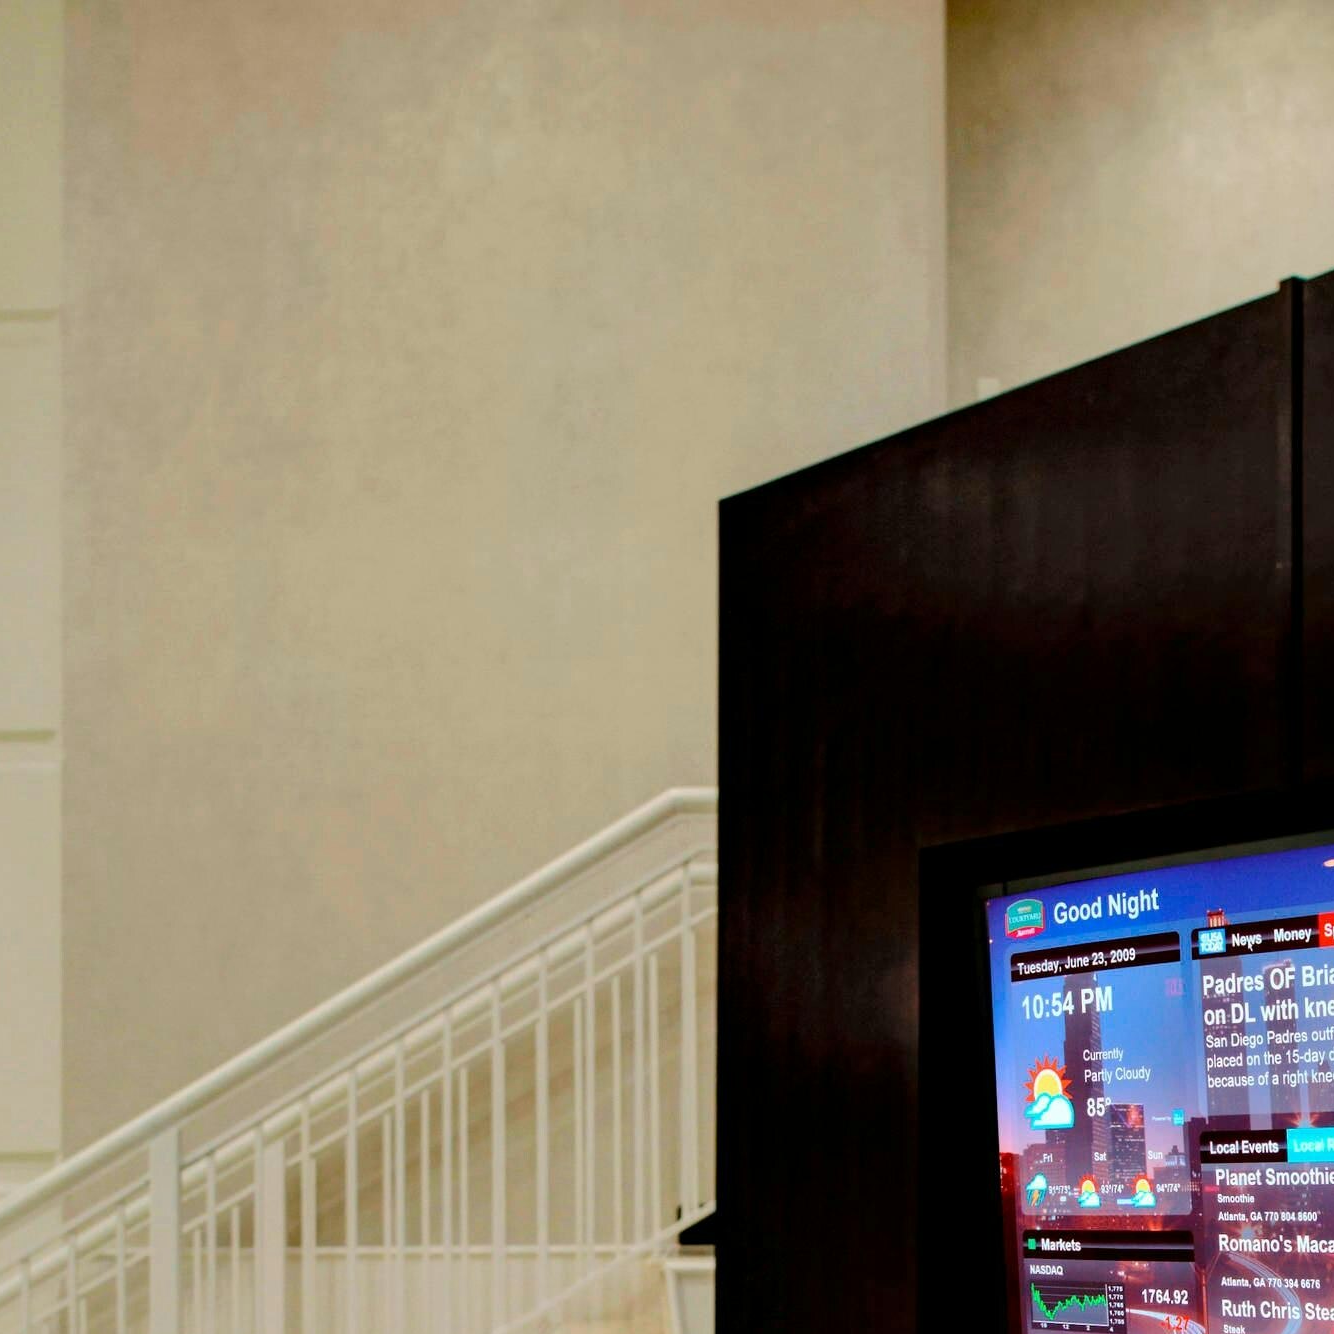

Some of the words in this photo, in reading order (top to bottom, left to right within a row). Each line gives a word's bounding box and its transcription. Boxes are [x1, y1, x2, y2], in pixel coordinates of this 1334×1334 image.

[1054, 897, 1102, 924] Good
[1108, 888, 1159, 919] Night
[1232, 933, 1262, 947] News
[1274, 928, 1312, 942] Money
[1018, 959, 1062, 975] Tuesday,
[1064, 955, 1089, 969] June
[1092, 952, 1107, 966] 23,
[1111, 948, 1136, 962] 2009
[1203, 973, 1264, 995] Padres
[1270, 967, 1295, 990] OF
[1022, 991, 1074, 1020] 10:54
[1081, 986, 1113, 1013] PM
[1204, 1008, 1226, 1025] on
[1231, 1003, 1256, 1024] DL
[1261, 999, 1298, 1021] with
[1206, 1035, 1227, 1048] San
[1231, 1033, 1263, 1048] Diego
[1267, 1030, 1307, 1044] Padres
[1083, 1048, 1123, 1061] Currently
[1207, 1053, 1243, 1071] placed
[1247, 1055, 1260, 1066] on
[1264, 1052, 1282, 1065] the
[1286, 1050, 1325, 1065] 15-day
[1084, 1069, 1112, 1084] Partly
[1115, 1066, 1150, 1081] Cloudy
[1207, 1075, 1254, 1088] because
[1258, 1072, 1269, 1085] of
[1272, 1074, 1279, 1085] a
[1283, 1070, 1308, 1087] right
[1210, 1141, 1238, 1155] Local
[1242, 1140, 1279, 1153] Events
[1293, 1139, 1324, 1153] Local
[1043, 1154, 1053, 1162] Fri
[1094, 1152, 1107, 1161] Sat
[1148, 1151, 1163, 1159] Sun
[1216, 1169, 1261, 1186] Planet
[1217, 1194, 1255, 1203] Smoothie
[1218, 1212, 1248, 1222] Atlanta,
[1251, 1212, 1262, 1221] GA
[1264, 1212, 1278, 1221] 770
[1281, 1212, 1295, 1221] 804
[1298, 1211, 1317, 1221] 8600
[1041, 1238, 1081, 1251] Markets
[1218, 1234, 1292, 1252] Romano's
[1030, 1265, 1063, 1275] NASDAQ
[1221, 1277, 1251, 1288] Atlanta,
[1253, 1278, 1265, 1287] GA
[1267, 1278, 1282, 1288] 770
[1284, 1278, 1299, 1288] 394
[1301, 1279, 1320, 1289] 6676
[1142, 1289, 1189, 1304] 1764.92
[1222, 1300, 1256, 1317] Ruth
[1260, 1301, 1300, 1319] Chris
[1223, 1325, 1246, 1334] Steak
